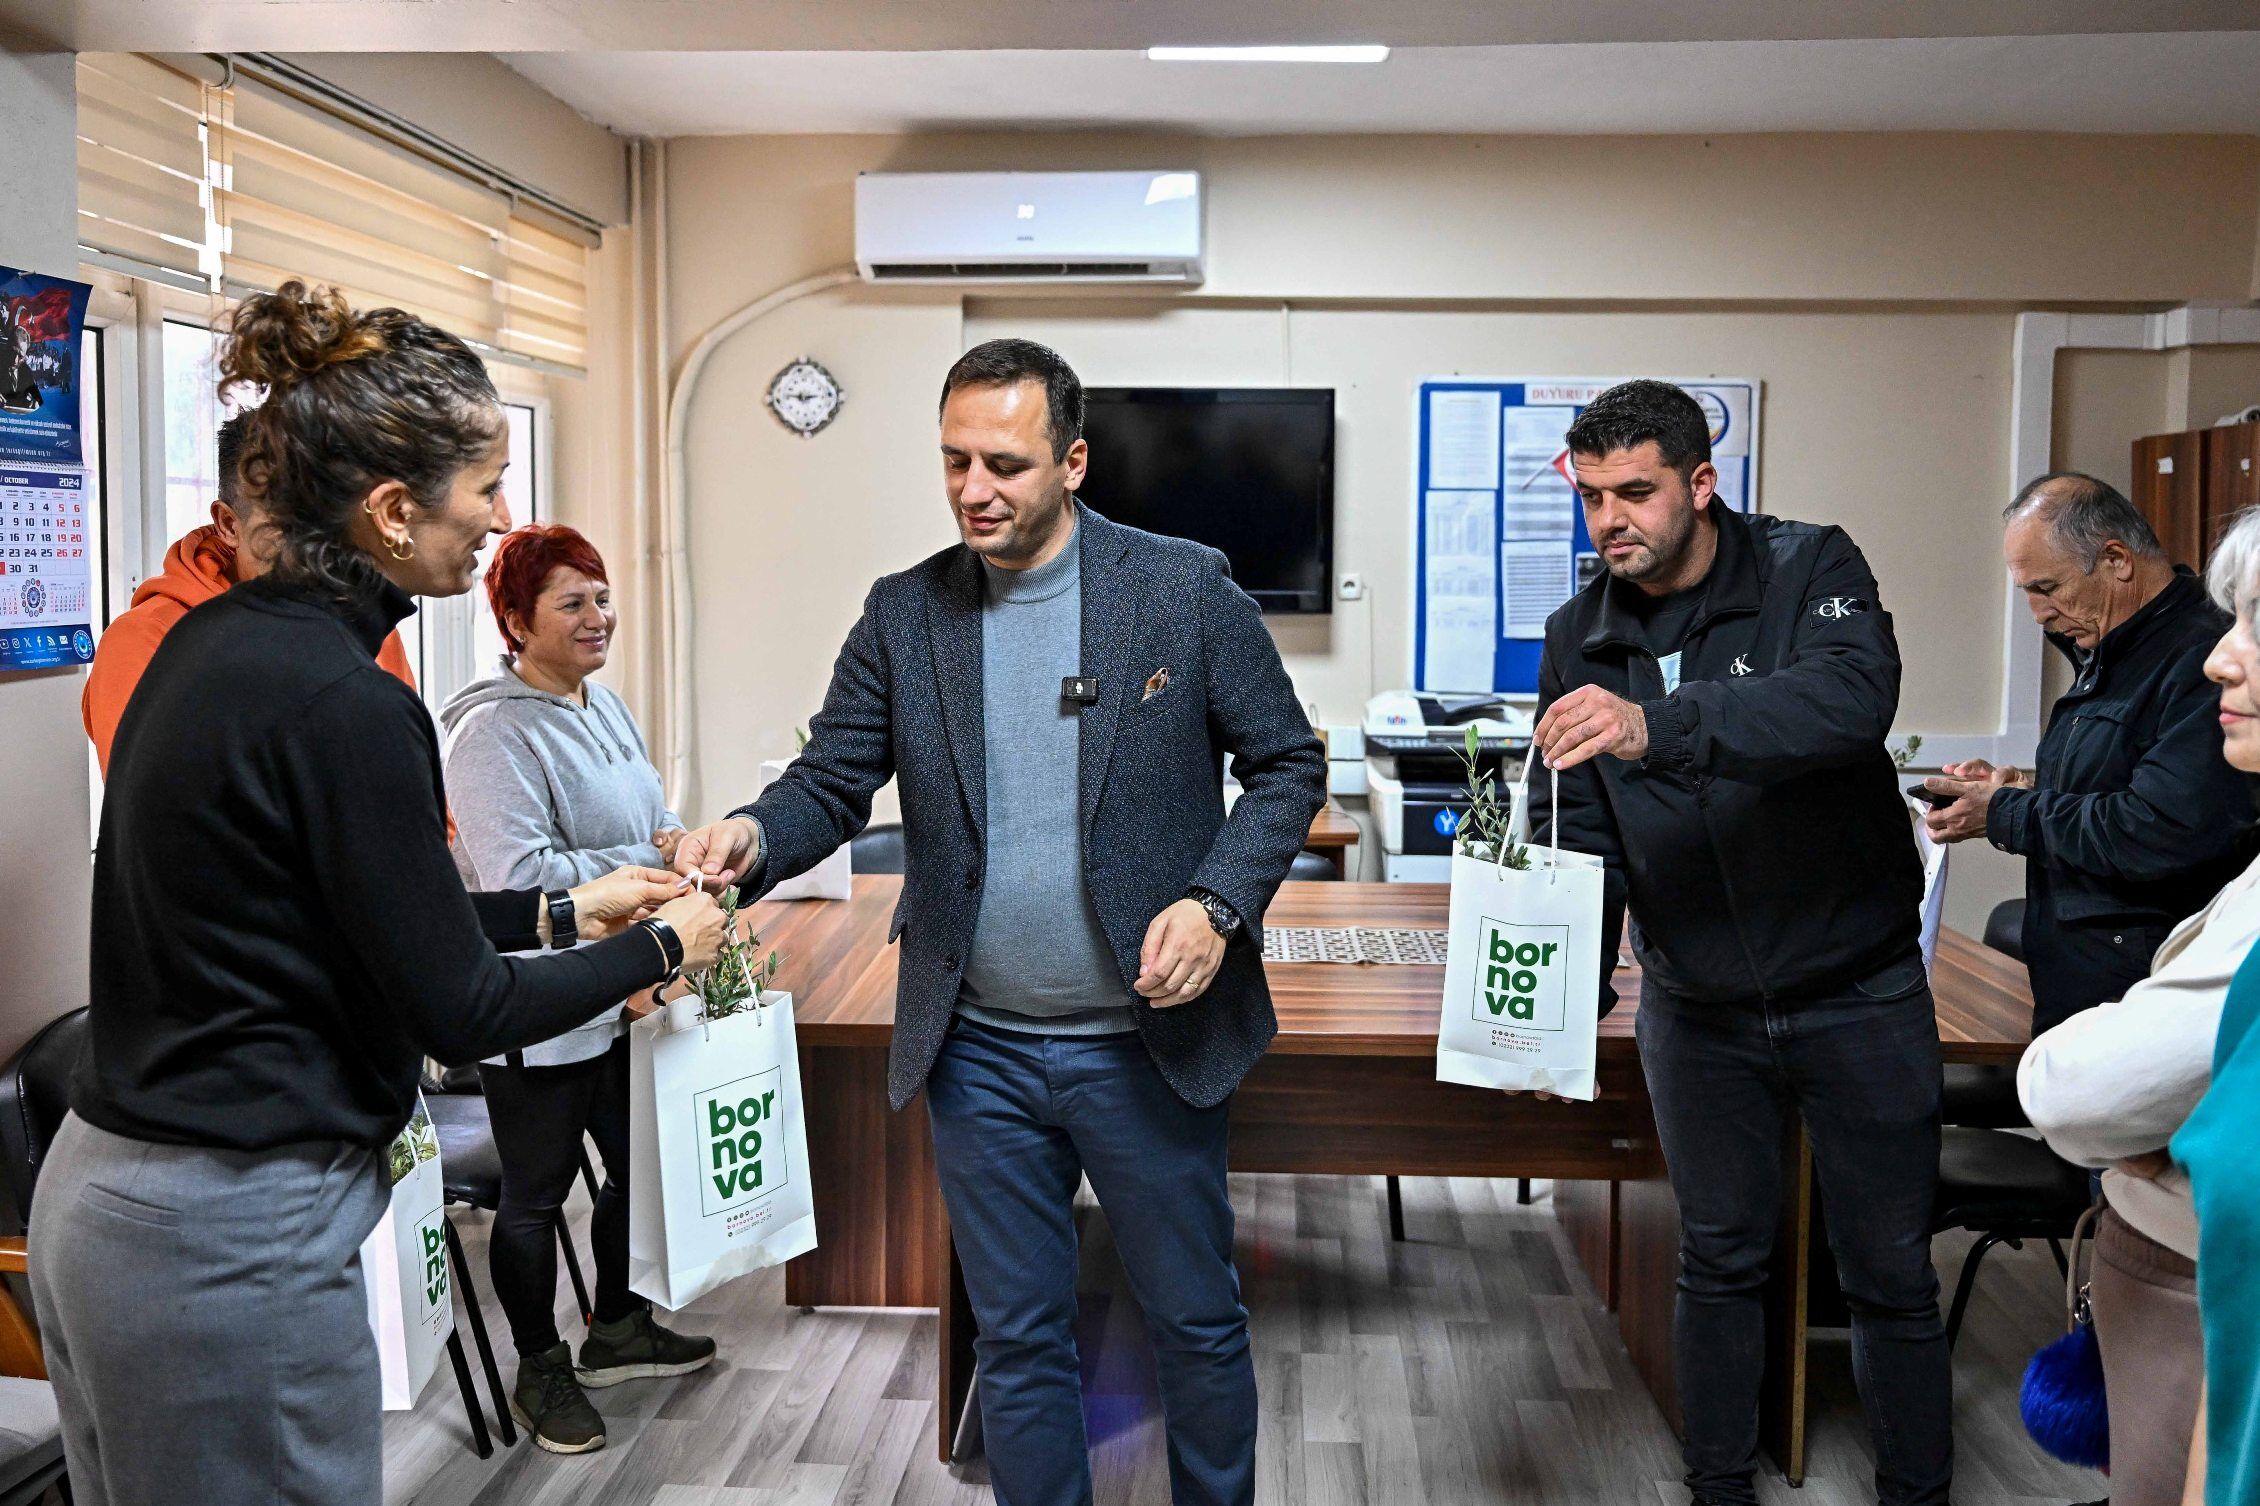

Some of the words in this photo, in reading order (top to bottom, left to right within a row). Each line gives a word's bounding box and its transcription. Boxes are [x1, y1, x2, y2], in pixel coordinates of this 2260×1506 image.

[1532, 388, 1582, 400] DUYURU
[4, 477, 29, 485] OCTOBER
[59, 477, 80, 488] 2024
[13, 502, 19, 511] 2
[29, 502, 35, 511] 3
[43, 503, 49, 511] 4
[59, 504, 65, 512] 5
[74, 504, 80, 513] 6
[13, 517, 19, 526] 9
[25, 518, 35, 527] 10
[42, 519, 50, 527] 11
[56, 519, 66, 528] 12
[72, 519, 81, 528] 13
[10, 533, 20, 541] 16
[26, 533, 35, 541] 17
[41, 534, 51, 542] 18
[57, 534, 67, 543] 19
[70, 534, 82, 543] 20
[9, 549, 20, 557] 23
[24, 549, 37, 557] 24
[41, 549, 53, 557] 25
[57, 549, 68, 557] 26
[72, 549, 83, 557] 27
[9, 564, 21, 573] 30
[28, 564, 38, 573] 31
[1489, 928, 1558, 967] bor
[1486, 964, 1538, 993] no
[1484, 991, 1535, 1020] va
[708, 1089, 775, 1138] bor
[711, 1130, 762, 1170] no
[712, 1159, 763, 1200] va
